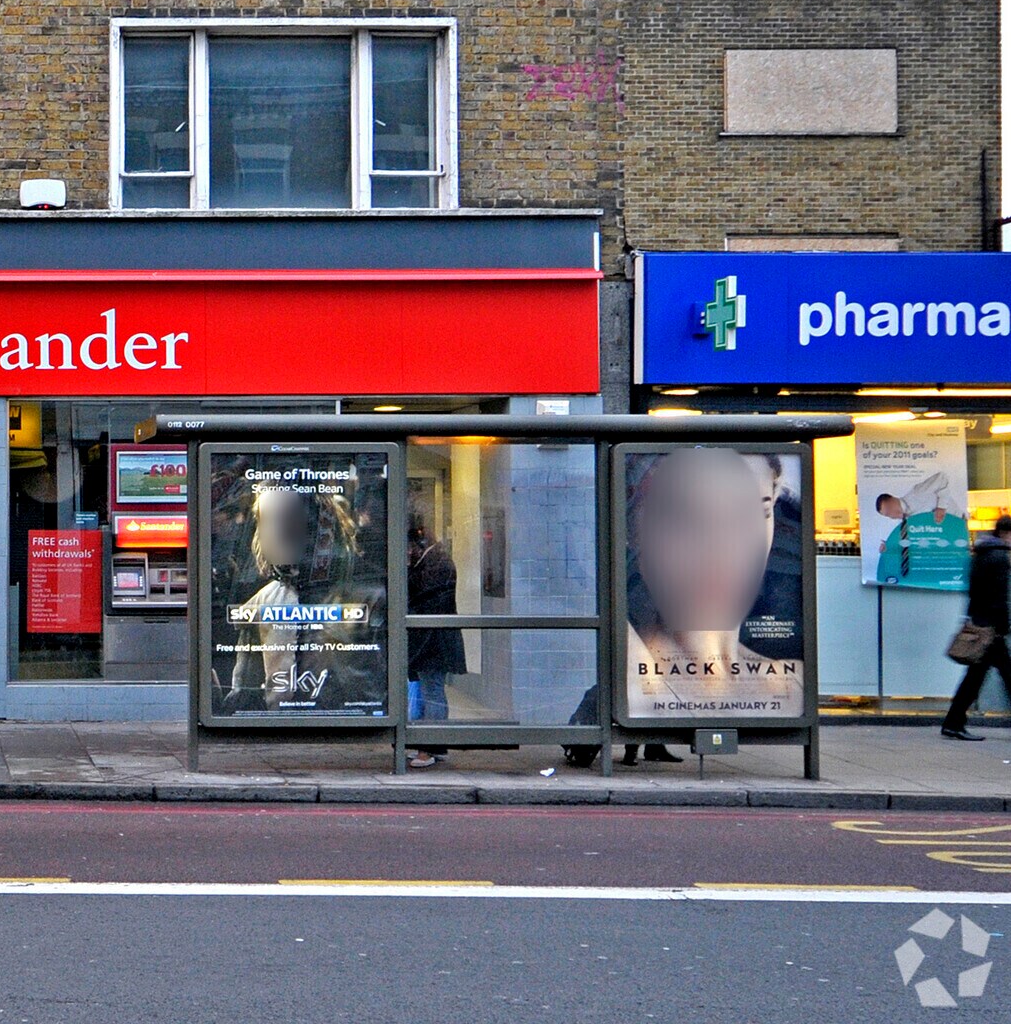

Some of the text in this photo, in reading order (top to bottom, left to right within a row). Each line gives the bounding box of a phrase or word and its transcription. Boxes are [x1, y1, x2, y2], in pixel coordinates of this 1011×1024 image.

[799, 290, 1011, 347] pharma
[185, 421, 205, 429] 0077
[862, 441, 870, 449] Is
[870, 441, 909, 449] QUITTING
[862, 451, 939, 460] of your 2011 goals?
[149, 464, 187, 478] £100
[245, 468, 350, 481] Game of Thrones
[291, 483, 316, 494] Sean
[318, 483, 344, 494] Bean
[140, 521, 185, 531] Santander
[909, 525, 943, 533] Quit Here
[32, 537, 80, 546] FREE cash
[230, 606, 364, 623] sky ATLANTIC HD
[216, 644, 234, 652] Free
[235, 644, 250, 652] and
[250, 644, 286, 652] exclusive
[286, 644, 299, 652] for
[310, 644, 324, 653] Sky
[638, 662, 796, 675] BLACK SWAN
[272, 664, 329, 699] sky
[653, 701, 781, 711] IN CINEMAS JANUARY 21
